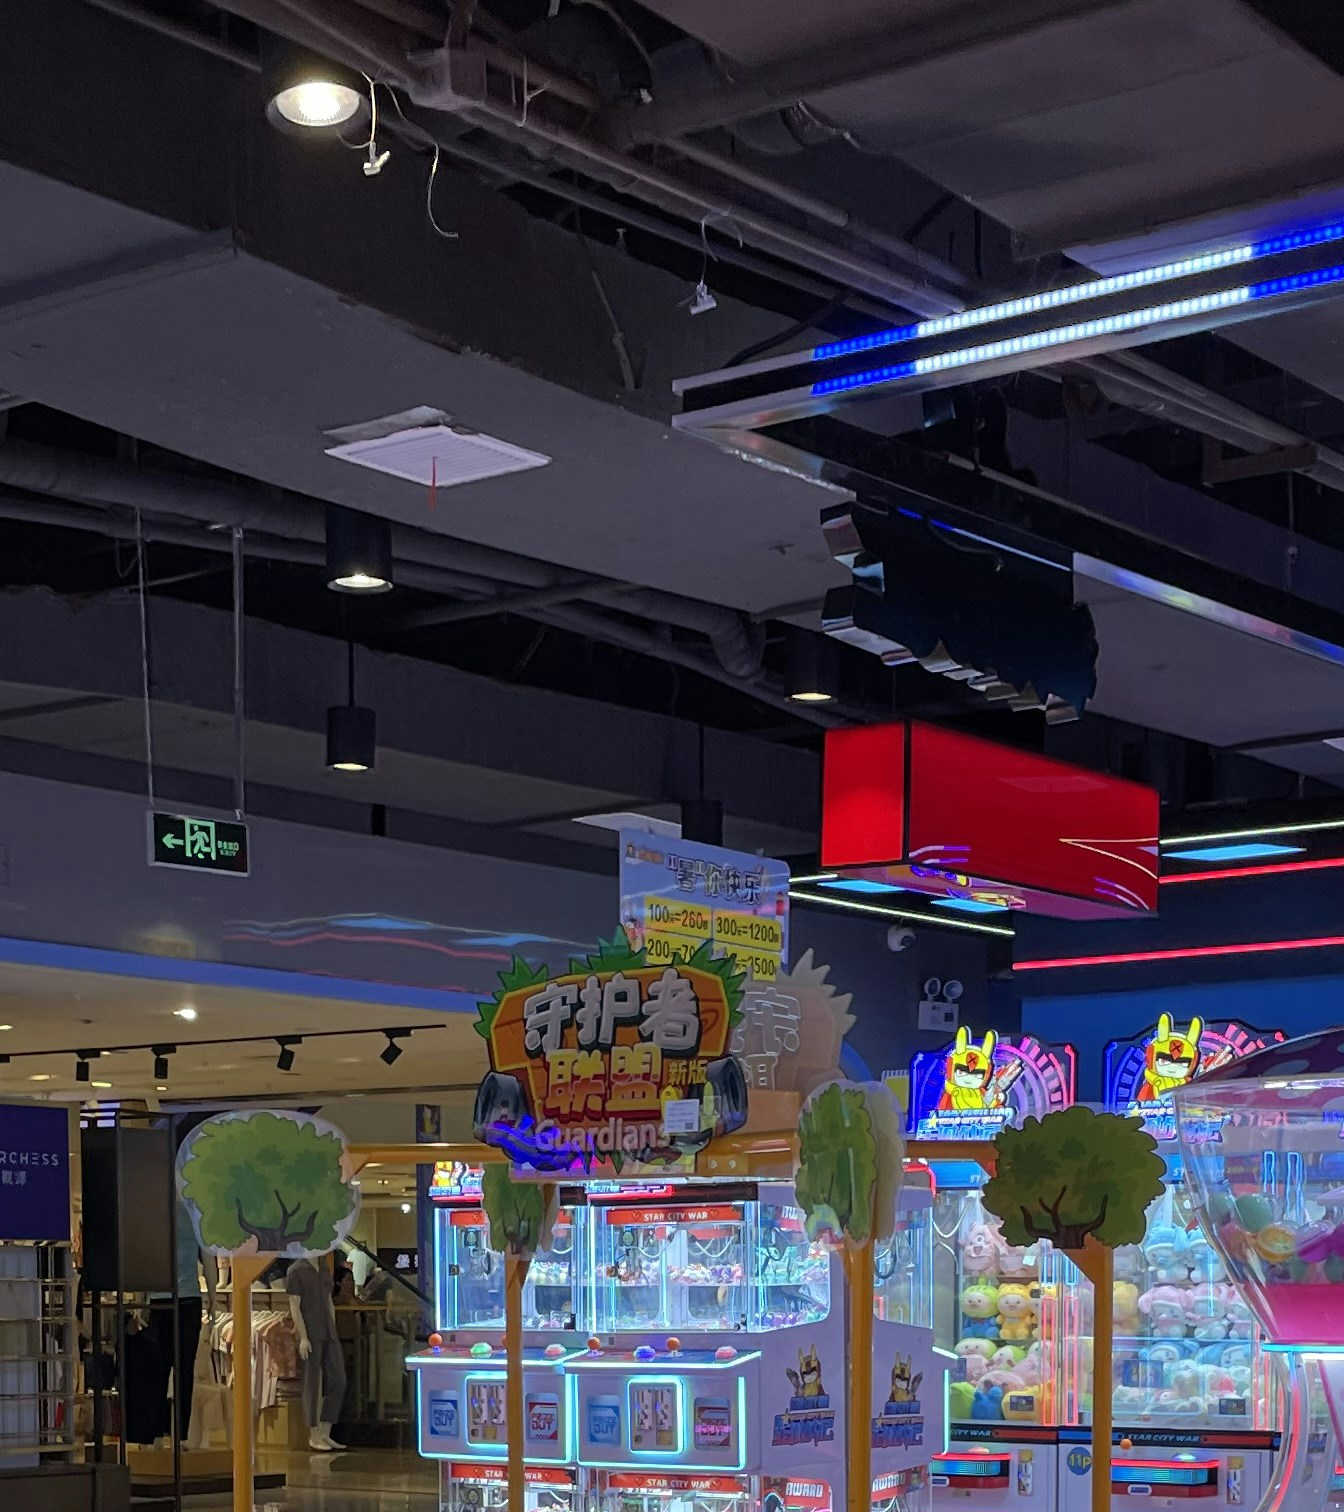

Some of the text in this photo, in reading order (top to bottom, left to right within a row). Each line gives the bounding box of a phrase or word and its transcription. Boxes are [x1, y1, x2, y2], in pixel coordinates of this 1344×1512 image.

[524, 968, 700, 1053] 守护者
[543, 1044, 662, 1121] 联盟
[785, 1482, 824, 1498] AWARD
